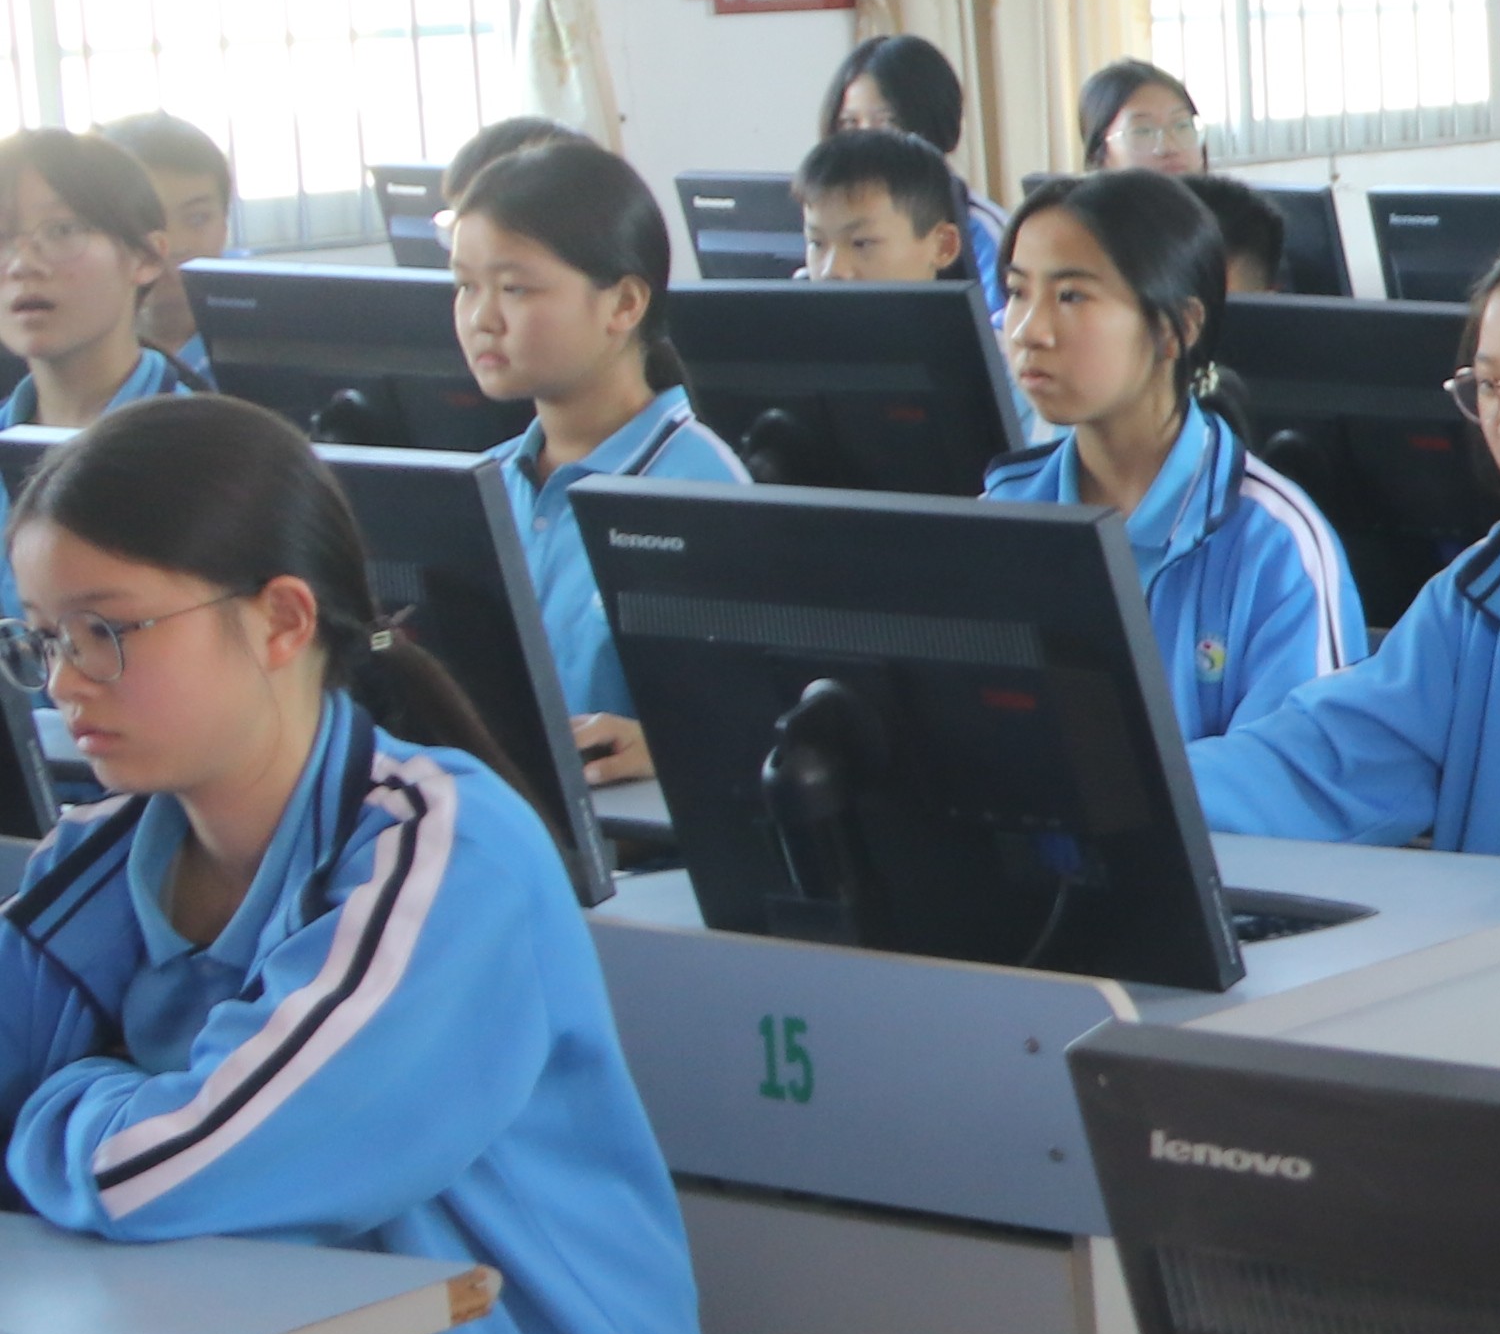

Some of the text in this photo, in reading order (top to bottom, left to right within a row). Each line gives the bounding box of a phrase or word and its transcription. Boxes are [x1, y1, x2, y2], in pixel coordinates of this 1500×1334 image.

[607, 526, 686, 553] lenovo
[757, 1013, 816, 1103] 15
[1149, 1128, 1314, 1182] lenovo
